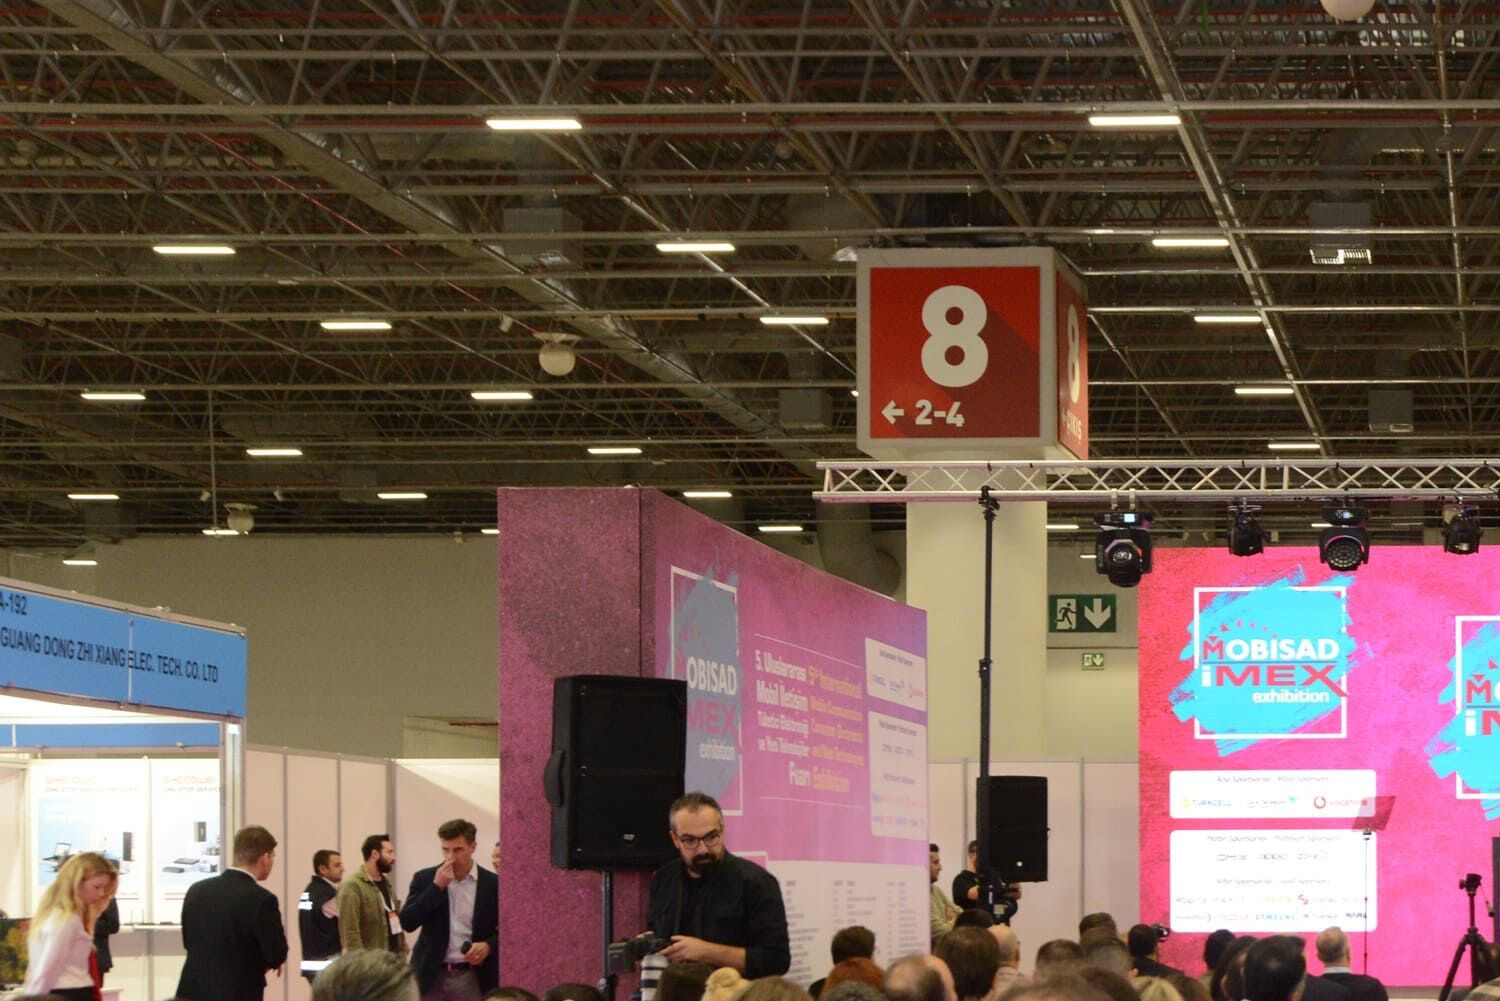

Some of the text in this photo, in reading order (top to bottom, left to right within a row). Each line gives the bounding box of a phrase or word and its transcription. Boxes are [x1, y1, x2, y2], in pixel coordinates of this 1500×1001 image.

[921, 285, 989, 388] 8
[1067, 303, 1080, 404] 8
[915, 399, 965, 427] 2-4
[1, 626, 40, 653] GUANG
[43, 635, 74, 660] DONG
[77, 640, 93, 662] ZHI
[95, 643, 125, 668] XIANG
[203, 663, 219, 683] LTD
[1252, 689, 1330, 703] exhibition
